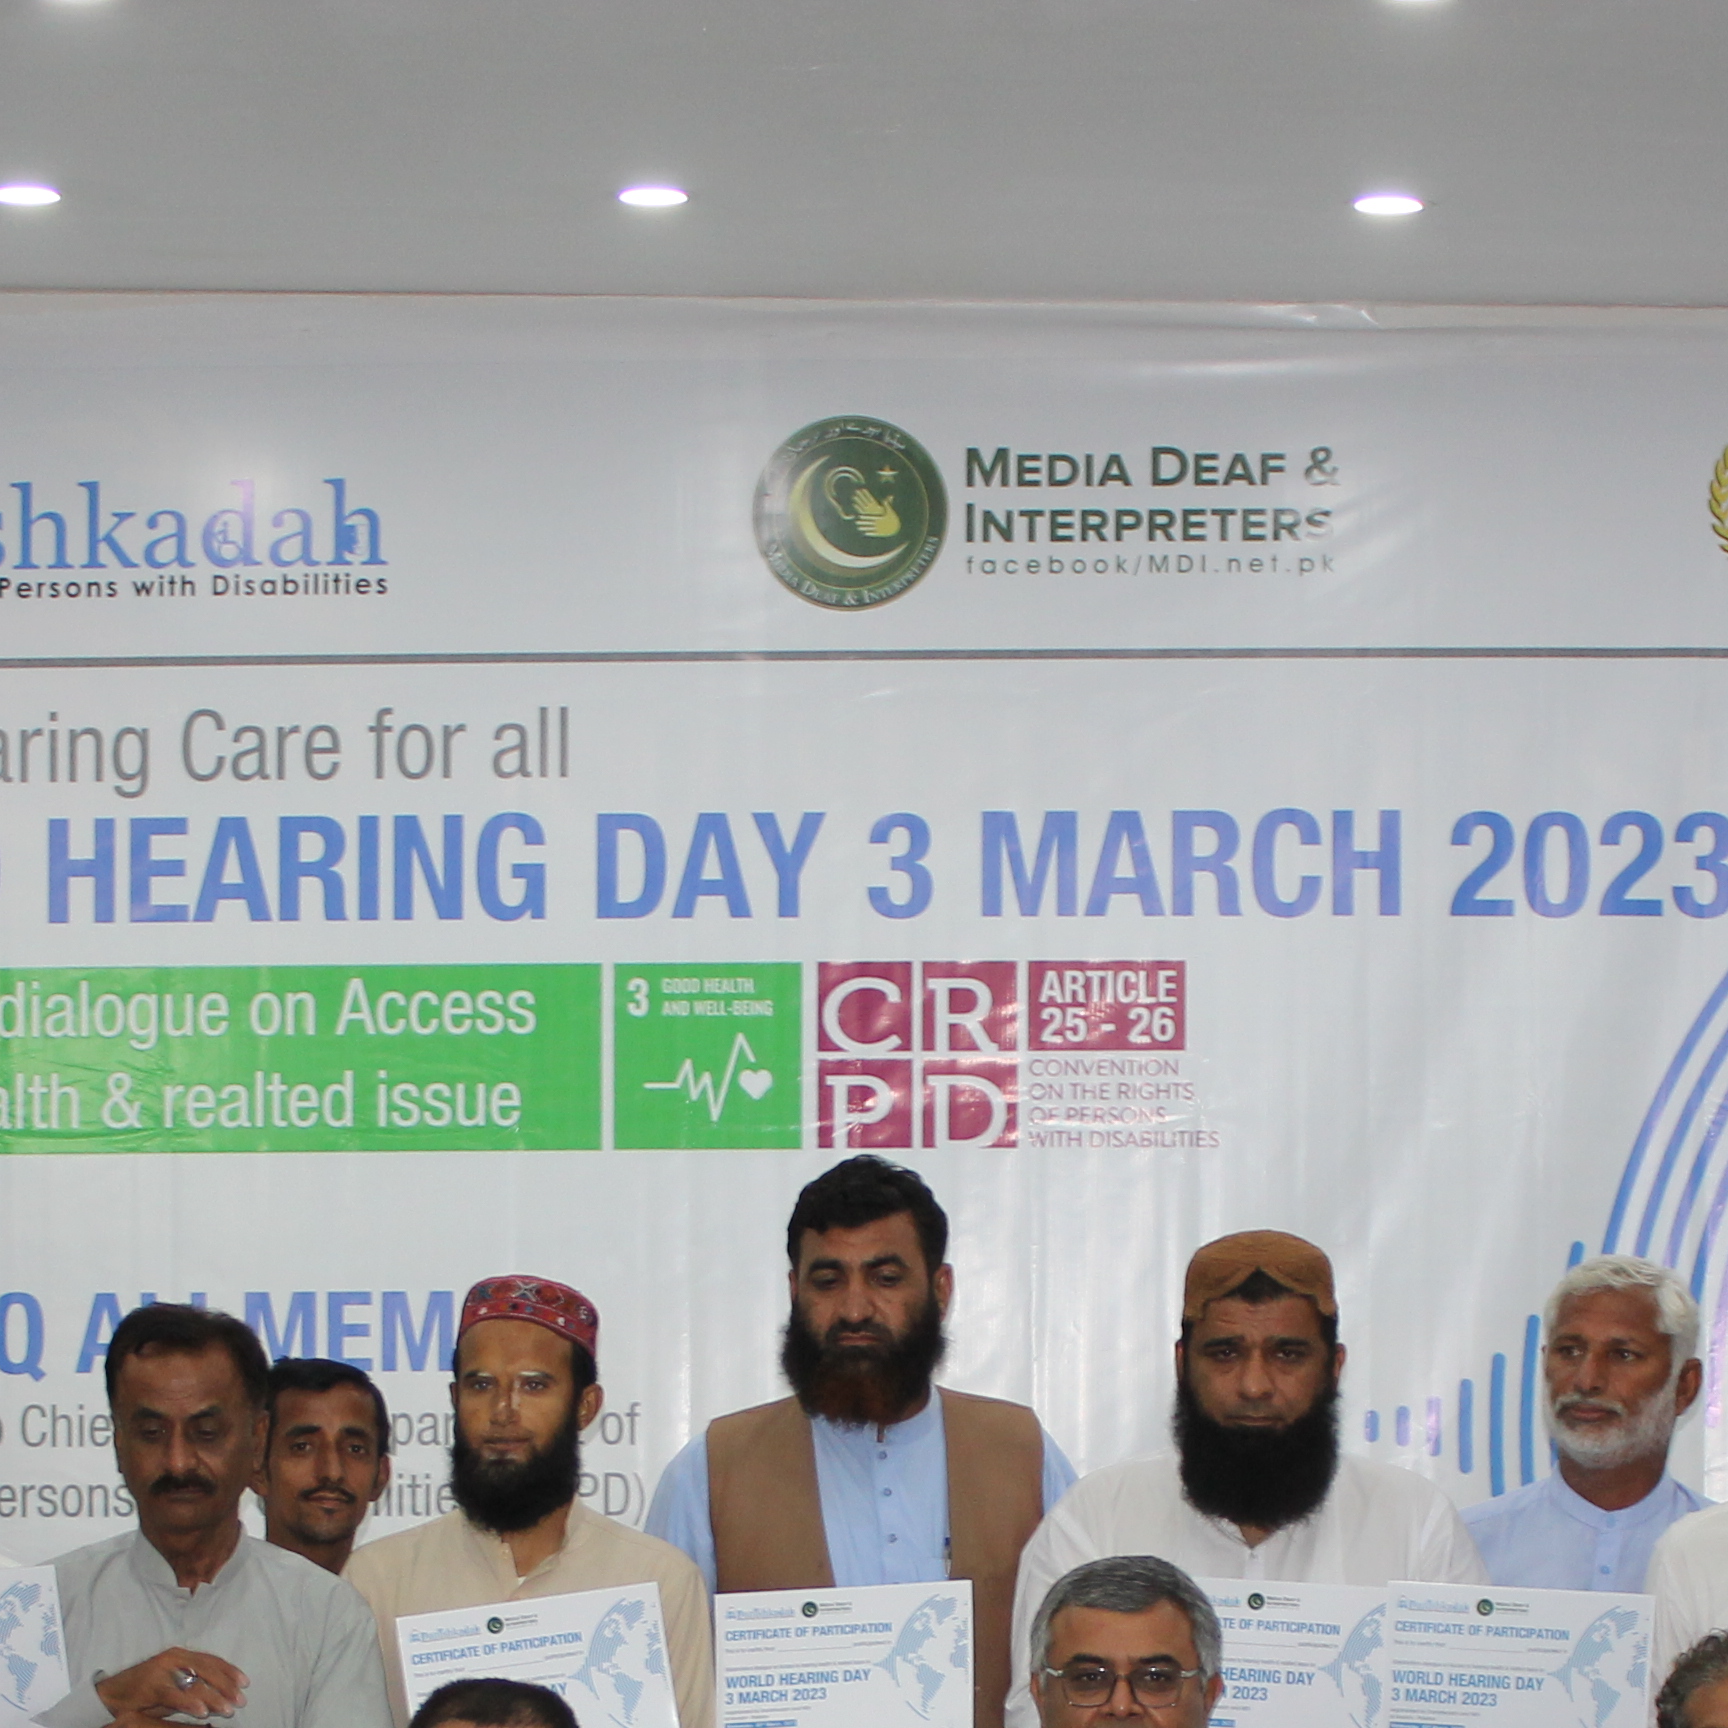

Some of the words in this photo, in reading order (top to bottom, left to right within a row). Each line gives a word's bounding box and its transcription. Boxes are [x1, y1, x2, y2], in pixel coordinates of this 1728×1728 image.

[965, 447, 1133, 488] MEDIA
[1152, 446, 1286, 488] DEAF
[1303, 445, 1341, 487] &
[965, 502, 1335, 543] INTERPRETERS
[134, 575, 196, 598] with
[212, 574, 389, 597] Disabilities
[180, 707, 341, 783] Care
[368, 706, 467, 781] for
[492, 704, 570, 779] all
[46, 812, 547, 925] HEARING
[595, 812, 826, 920] DAY
[866, 810, 934, 921] 3
[980, 808, 1402, 918] MARCH
[662, 977, 701, 994] GOOD
[703, 977, 755, 994] HEALTH
[1039, 969, 1178, 1006] ARTICLE
[249, 992, 316, 1037] on
[335, 978, 538, 1036] Access
[626, 977, 650, 1018] 3
[662, 1000, 691, 1016] AND
[692, 1000, 774, 1016] WELL-BEING
[1039, 1006, 1087, 1043] 25
[1127, 1006, 1176, 1043] 26
[1028, 1058, 1181, 1076] CONVENTION
[100, 1073, 144, 1130] &
[162, 1070, 355, 1130] realted
[376, 1070, 522, 1128] issue
[1029, 1082, 1064, 1100] ON
[1069, 1082, 1111, 1100] THE
[1117, 1082, 1195, 1100] RIGHTS
[1065, 1106, 1167, 1124] PERSONS
[1029, 1131, 1082, 1148] WITH
[1089, 1131, 1221, 1149] DISABILITIES
[19, 1404, 114, 1449] Chie
[601, 1403, 641, 1446] of
[412, 1647, 480, 1665] CERTIFICATE
[501, 1631, 582, 1652] PARTICIPATION
[726, 1674, 774, 1689] WORLD
[780, 1671, 839, 1686] HEARING
[844, 1669, 871, 1681] DAY
[1286, 1671, 1315, 1685] DAY
[1393, 1670, 1443, 1685] WORLD
[1449, 1673, 1511, 1689] HEARING
[1516, 1677, 1544, 1691] DAY
[739, 1690, 789, 1704] MARCH
[793, 1688, 827, 1701] 2023
[1233, 1686, 1268, 1700] 2023
[1405, 1689, 1458, 1704] MARCH
[1462, 1693, 1497, 1706] 2023
